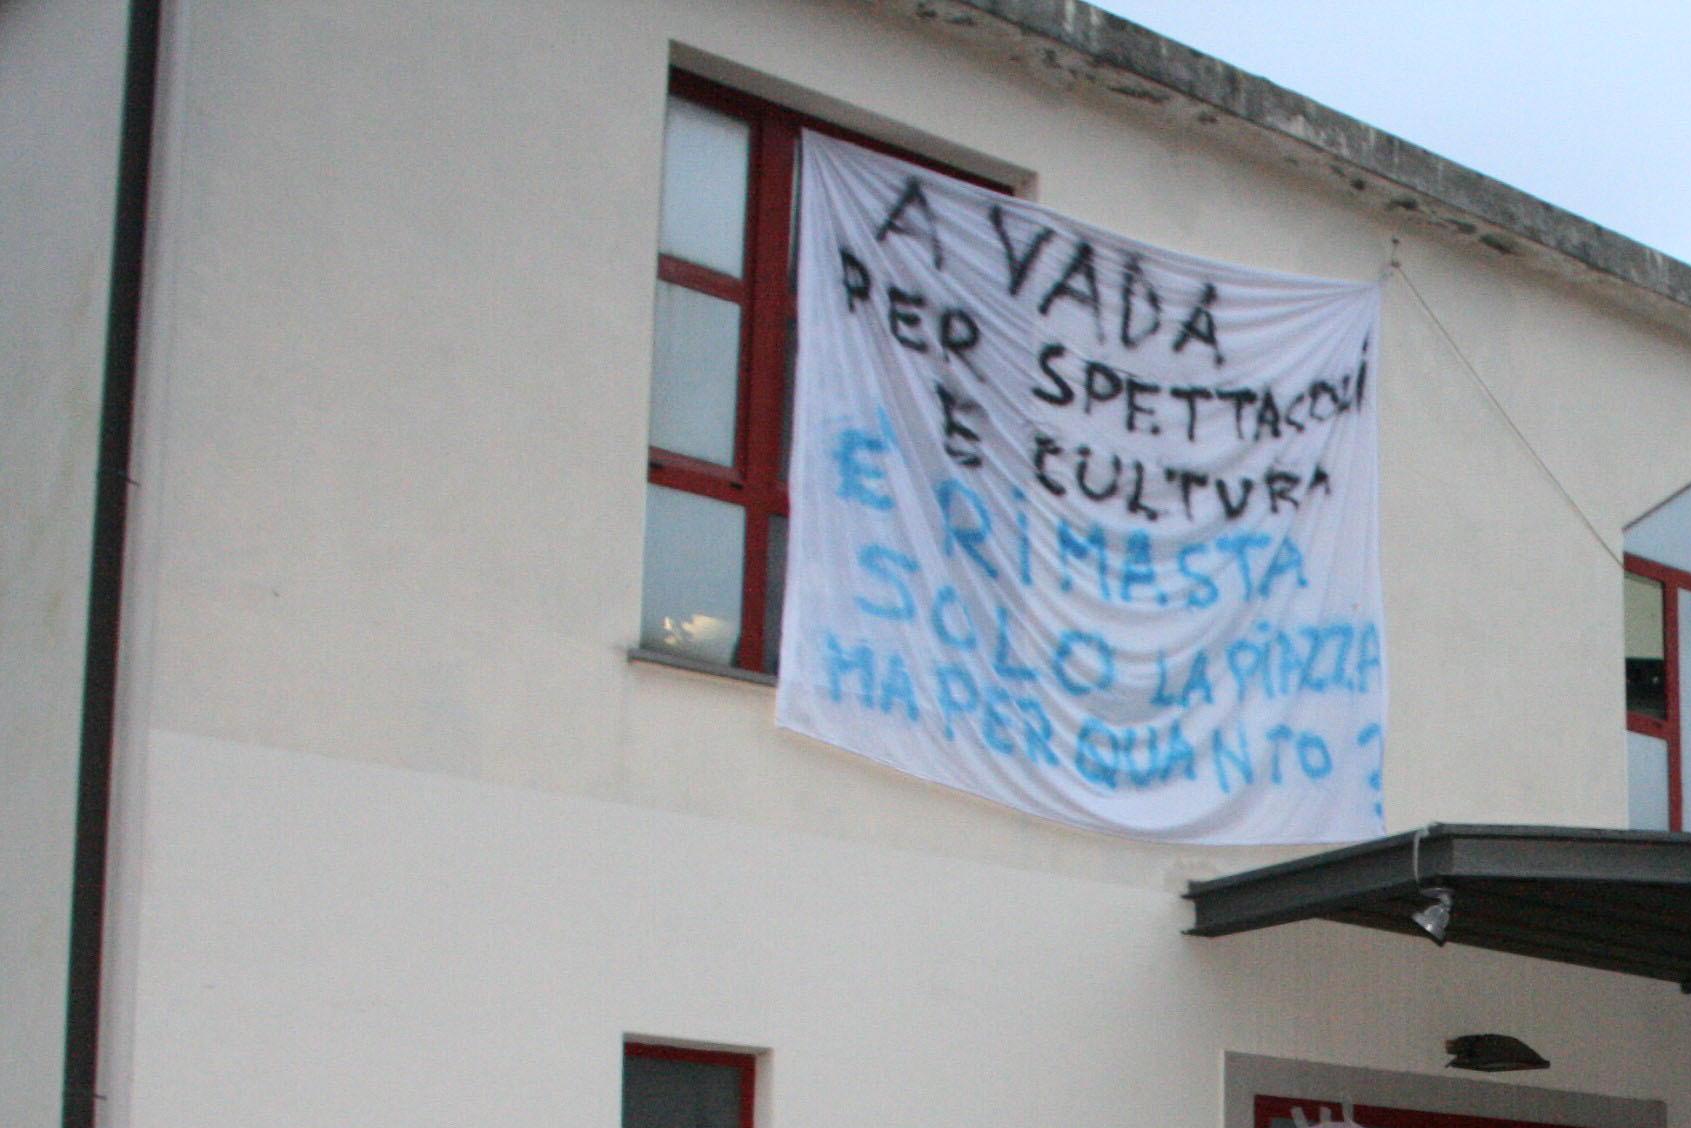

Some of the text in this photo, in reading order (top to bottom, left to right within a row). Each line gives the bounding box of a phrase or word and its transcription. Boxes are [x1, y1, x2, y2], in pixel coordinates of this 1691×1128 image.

[837, 244, 986, 386] PER
[876, 175, 1226, 368] A VADA
[935, 380, 1333, 522] E CULTURA
[933, 477, 1309, 609] RIMASTA
[853, 542, 1382, 708] SOLO LA PIAZZA
[933, 660, 1060, 768] PER
